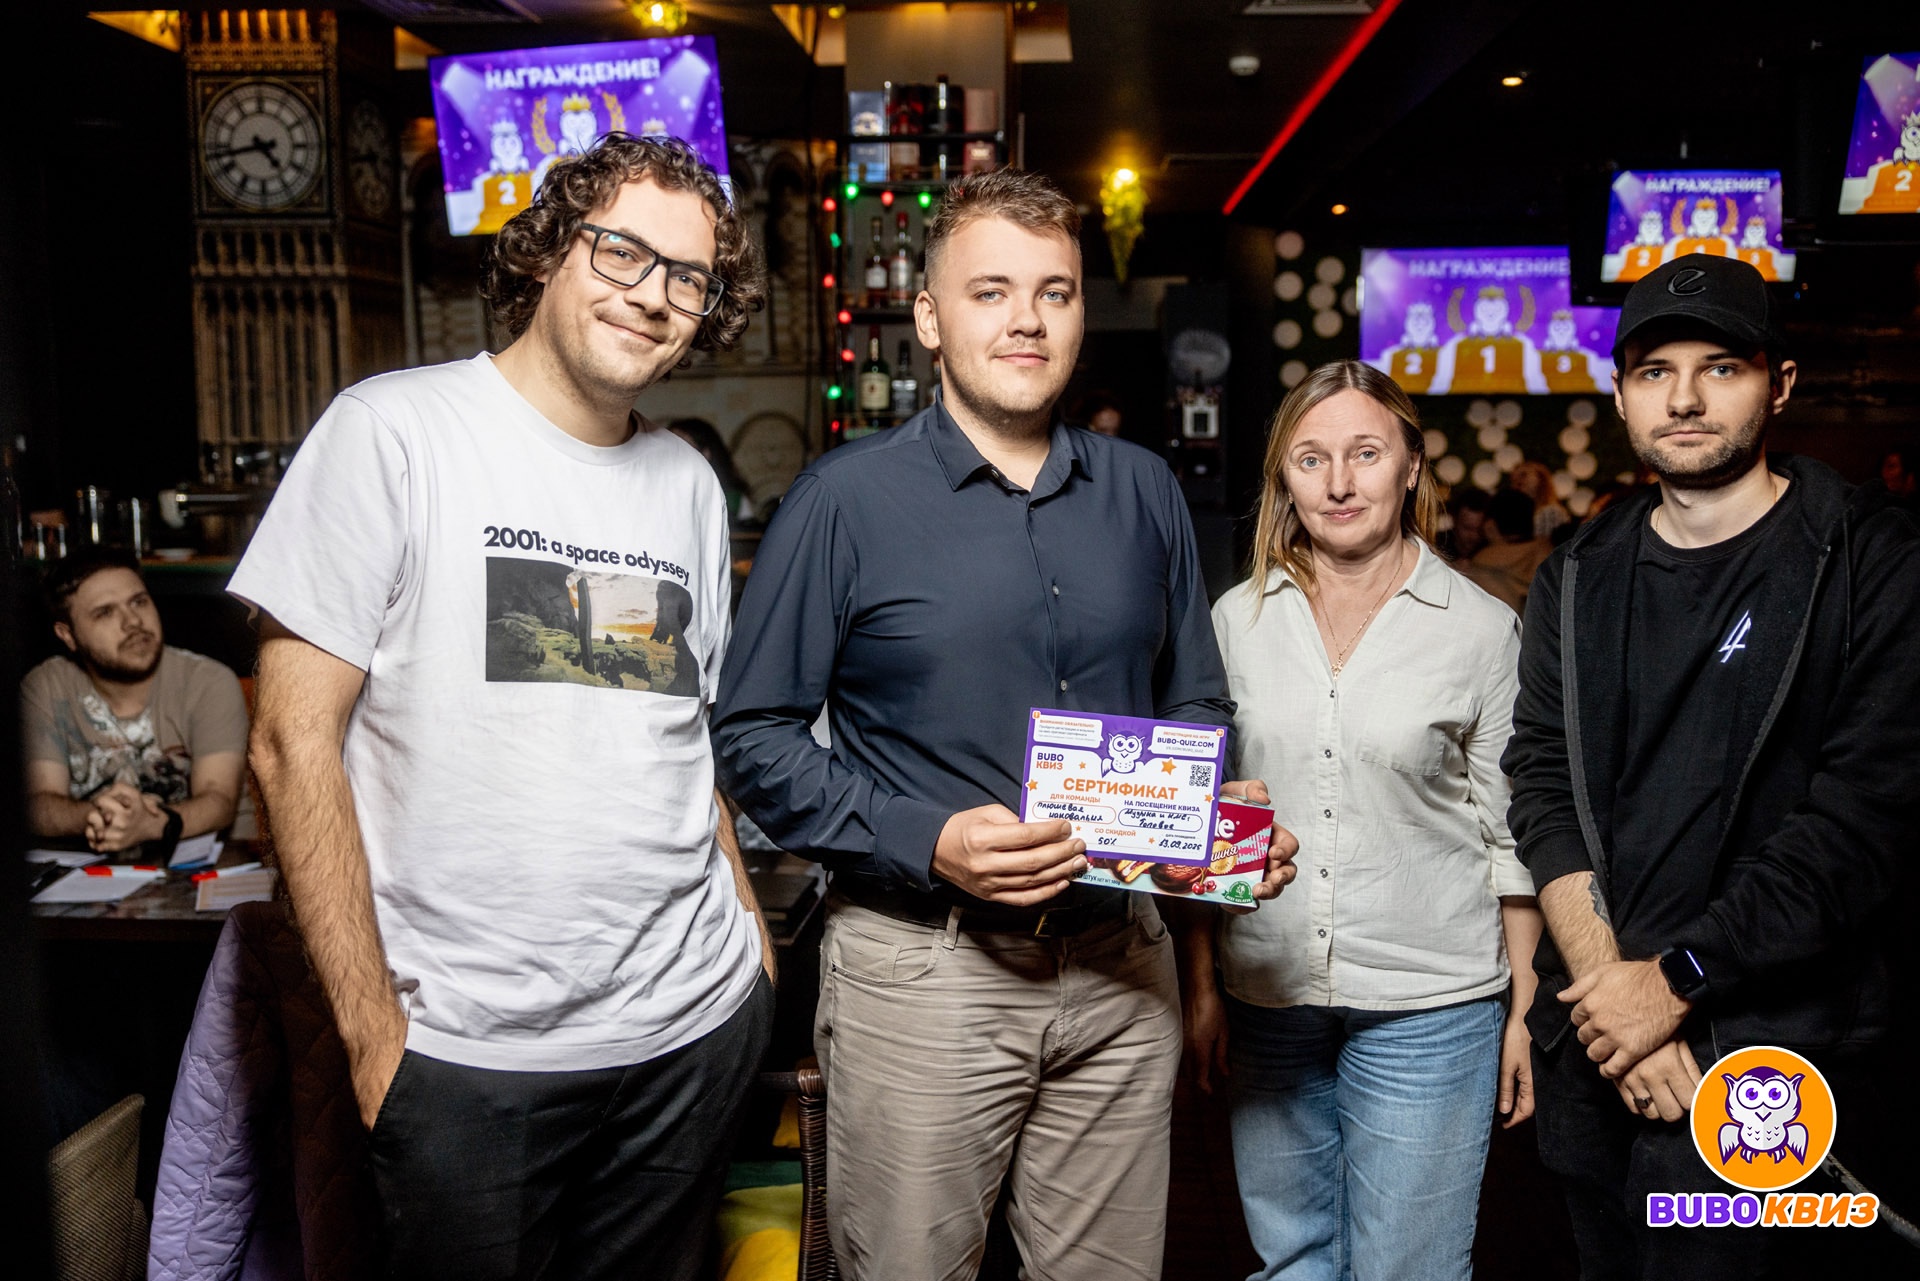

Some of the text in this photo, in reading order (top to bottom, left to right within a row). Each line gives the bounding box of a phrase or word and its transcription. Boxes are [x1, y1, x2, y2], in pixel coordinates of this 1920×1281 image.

[485, 57, 660, 89] НАГРАЖДЕНИЕ!
[1645, 176, 1771, 194] НАГРАЖДЕНИЕ!
[1894, 169, 1913, 192] 2
[497, 180, 518, 206] 2
[1637, 250, 1651, 268] 2
[1404, 352, 1424, 376] 2
[1480, 345, 1497, 374] 1
[1556, 355, 1573, 374] 3
[484, 525, 690, 587] 2001: a space odyssey
[1157, 737, 1215, 748] BUBO-QUIZ.COM
[1036, 761, 1063, 770] КВИЗ
[1037, 752, 1064, 761] BUBO
[1063, 777, 1178, 800] СЕРТИФИКАТ
[1065, 794, 1101, 803] КОМАНДЫ
[1135, 801, 1177, 810] ПОСЕЩЕНИЕ
[1097, 836, 1117, 845] 50%
